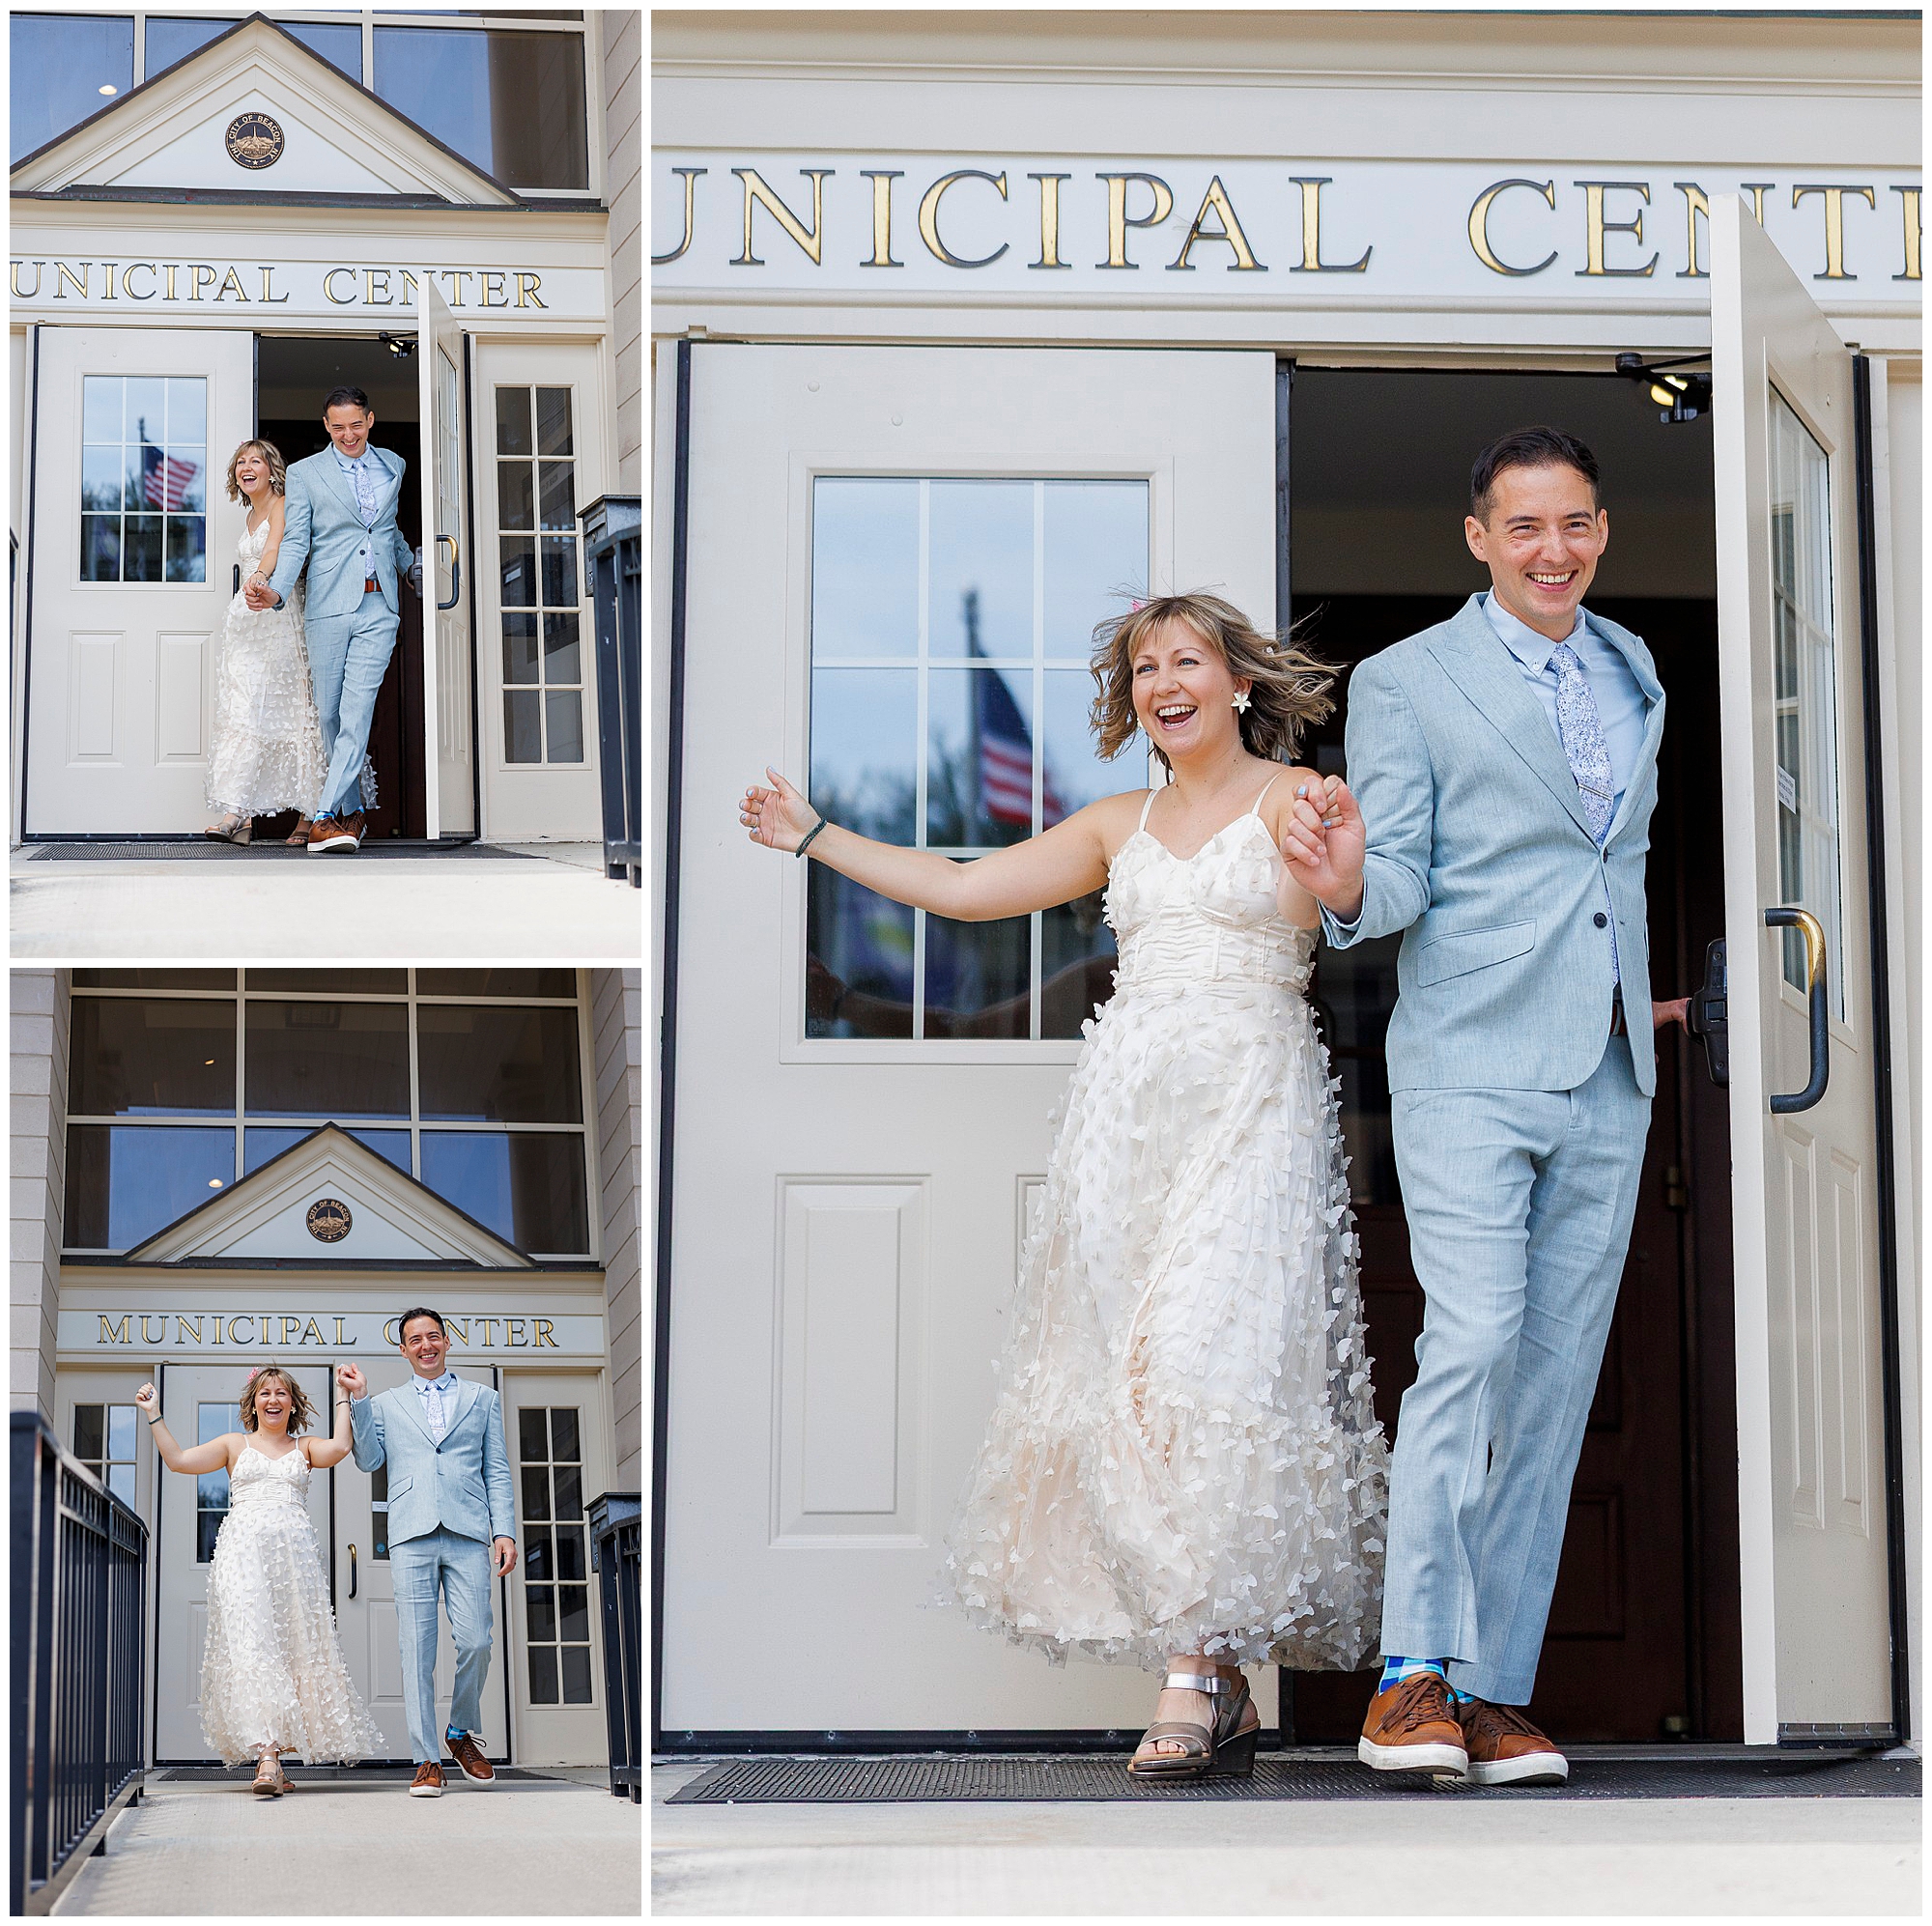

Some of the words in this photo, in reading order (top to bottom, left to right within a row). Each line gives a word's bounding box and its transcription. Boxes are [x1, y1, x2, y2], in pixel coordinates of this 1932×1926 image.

[229, 122, 241, 139] CITY
[257, 116, 281, 143] BEACON
[229, 143, 241, 158] THE
[270, 148, 278, 159] NY
[10, 261, 290, 302] UNICIPAL
[308, 1206, 318, 1220] CITY
[97, 1315, 357, 1345] MUNICIPAL
[383, 1317, 559, 1347] CNTER
